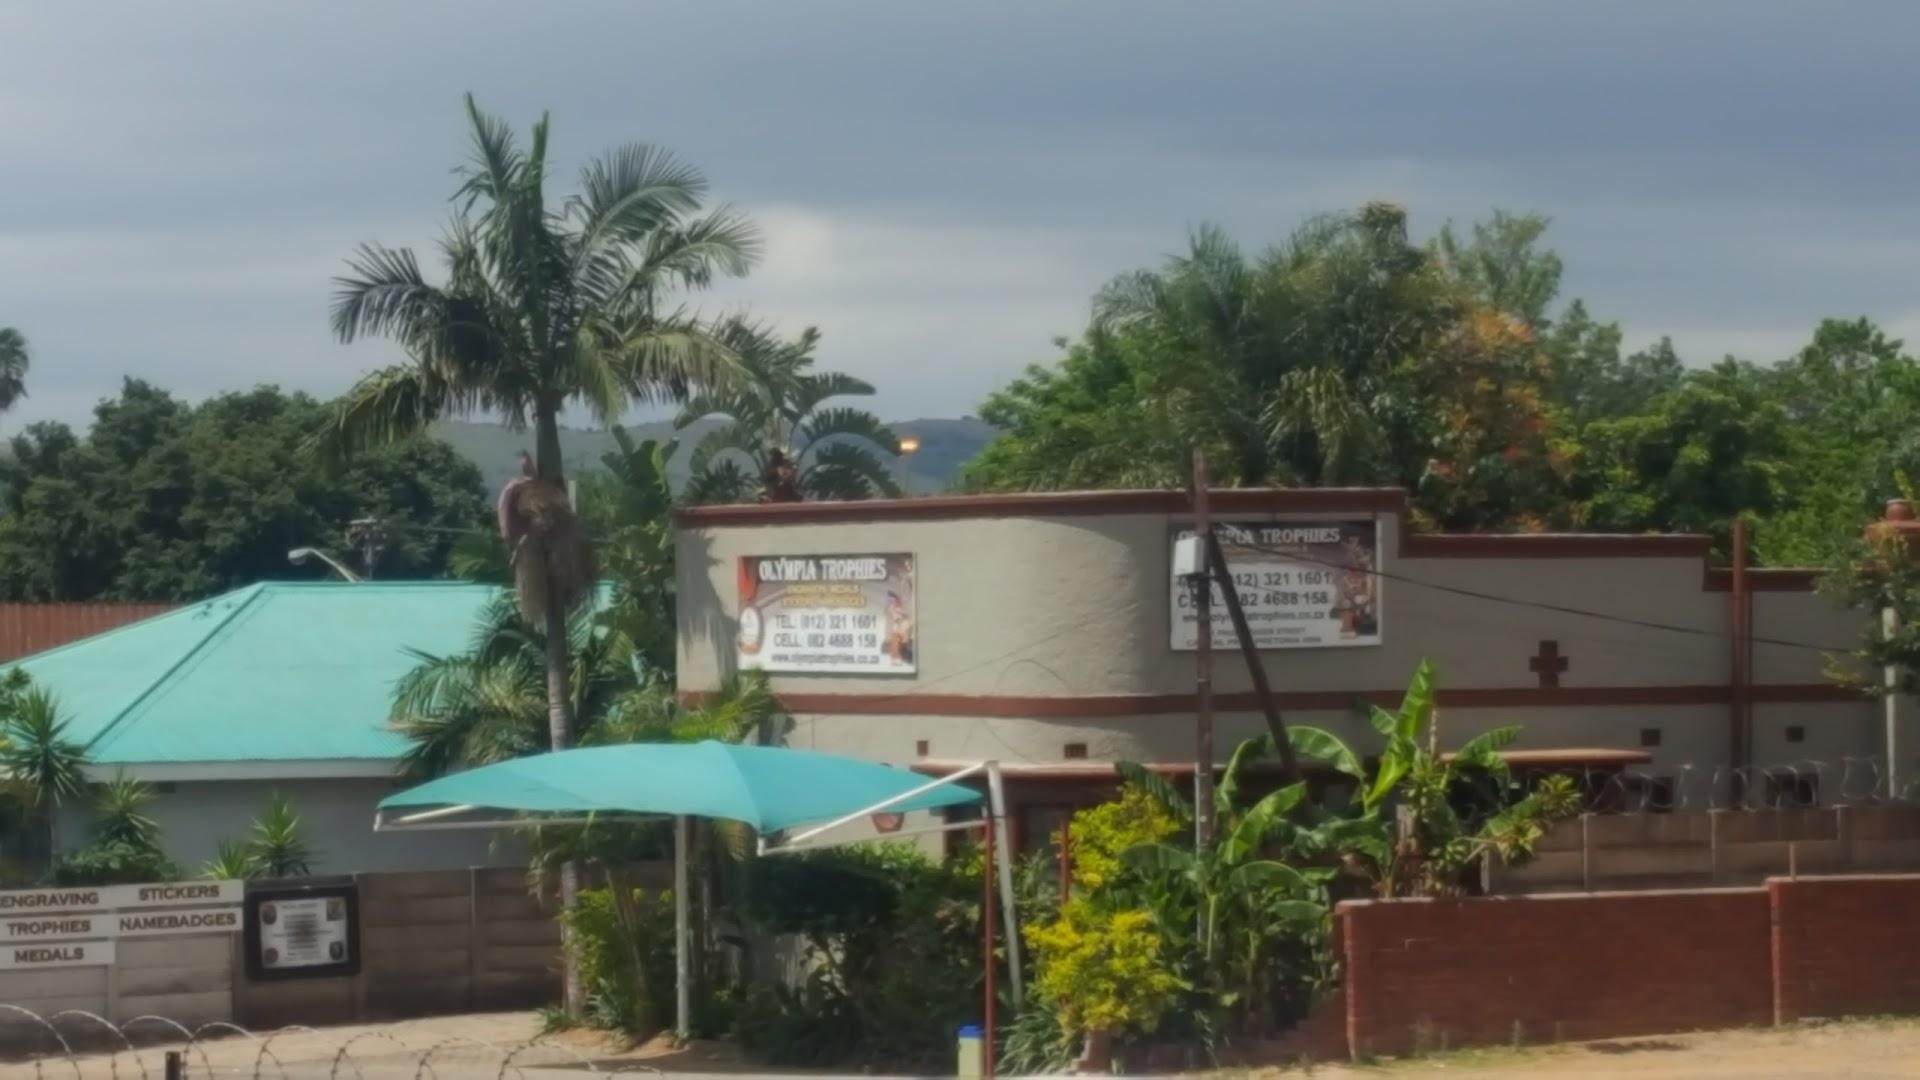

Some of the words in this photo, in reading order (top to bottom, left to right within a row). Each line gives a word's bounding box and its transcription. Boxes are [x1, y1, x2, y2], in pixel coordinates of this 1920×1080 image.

[1260, 528, 1340, 543] TROPHIES
[758, 557, 817, 581] OLYMPIA
[820, 558, 887, 580] TROPHIES
[1264, 572, 1290, 586] 321
[1297, 571, 1330, 585] 1601
[1302, 591, 1329, 605] 158
[829, 614, 847, 629] 321
[0, 892, 99, 909] ENGRAVING
[139, 885, 220, 901] STICKERS
[7, 920, 91, 936] TROPHIES
[119, 913, 237, 931] NAMEBADGES
[14, 948, 84, 963] MEDALS
